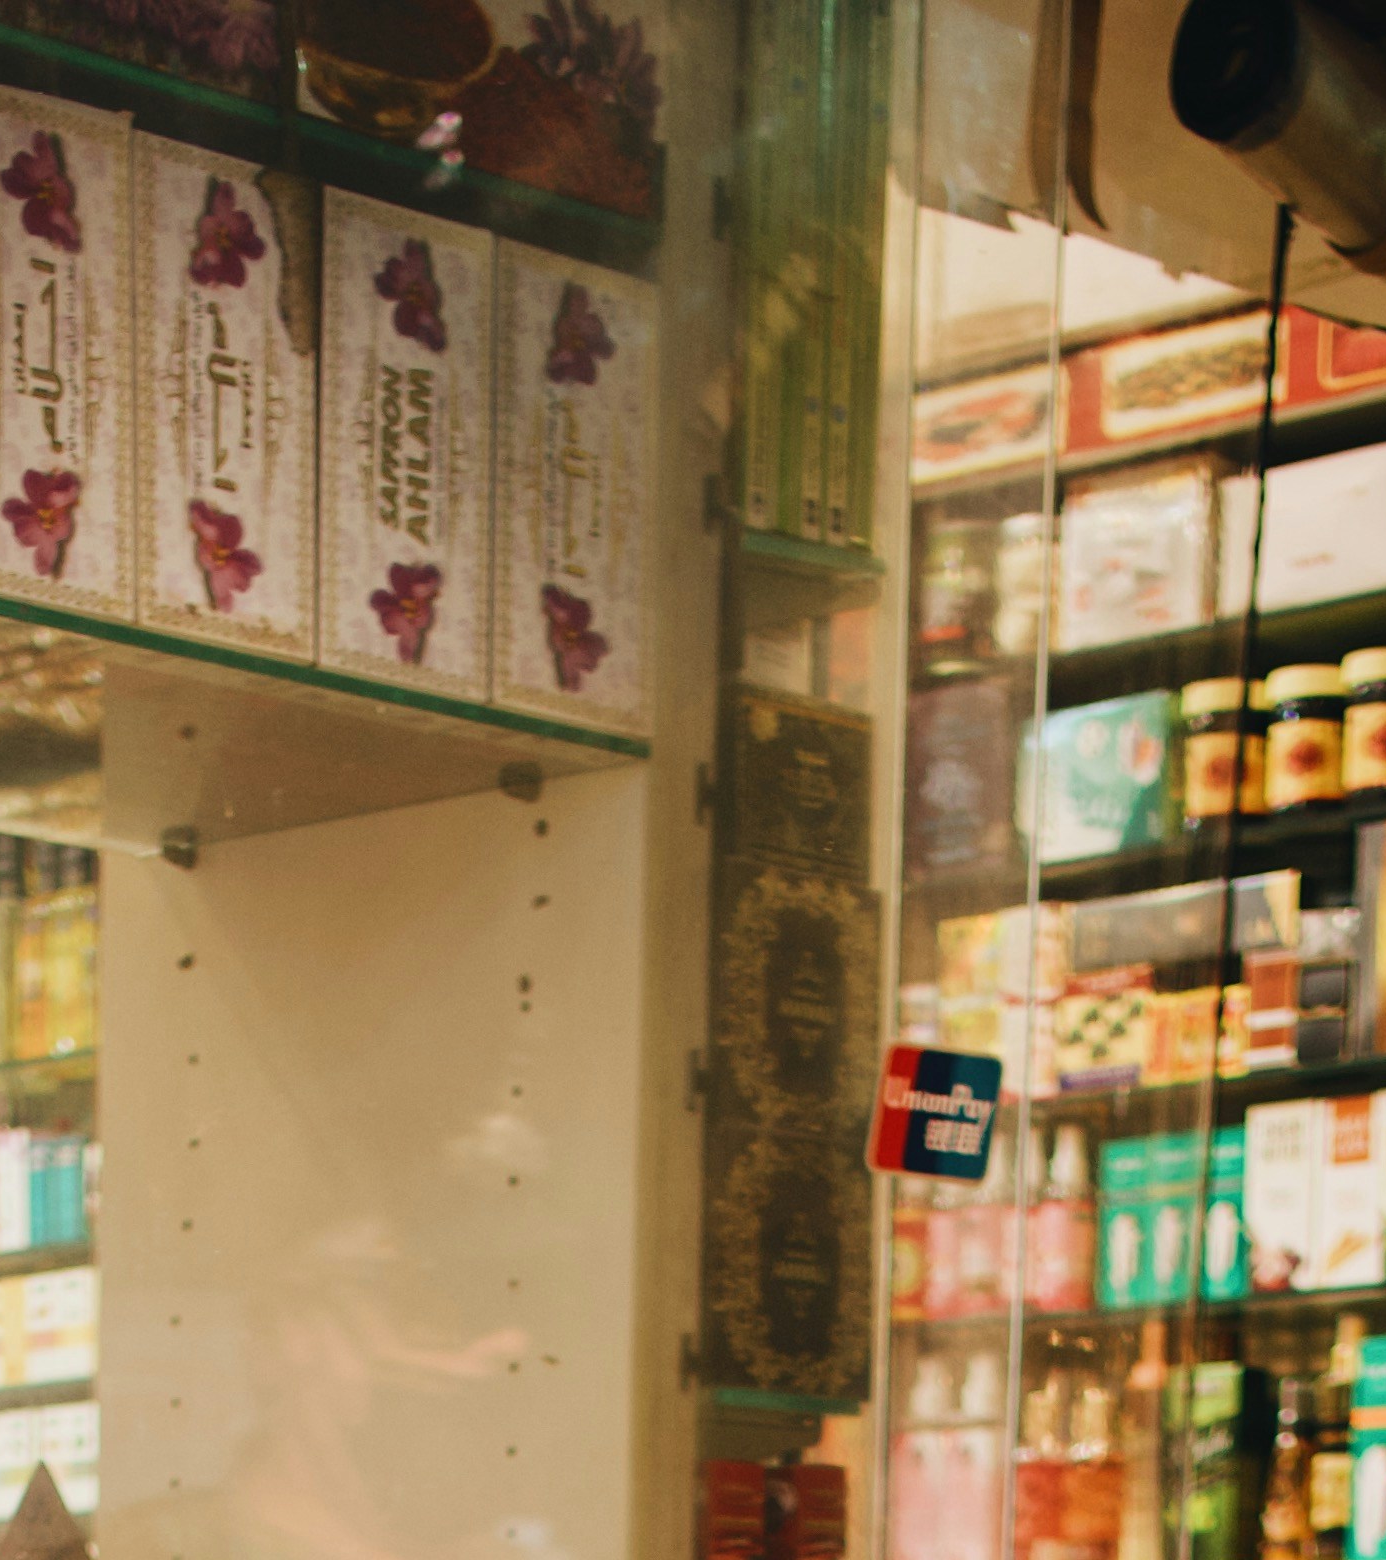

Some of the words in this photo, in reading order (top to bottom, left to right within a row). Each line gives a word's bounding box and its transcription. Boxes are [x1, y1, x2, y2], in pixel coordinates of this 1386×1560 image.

[380, 363, 402, 529] SAFFRON
[406, 367, 433, 546] AHLAM
[883, 1076, 993, 1142] UnionPay
